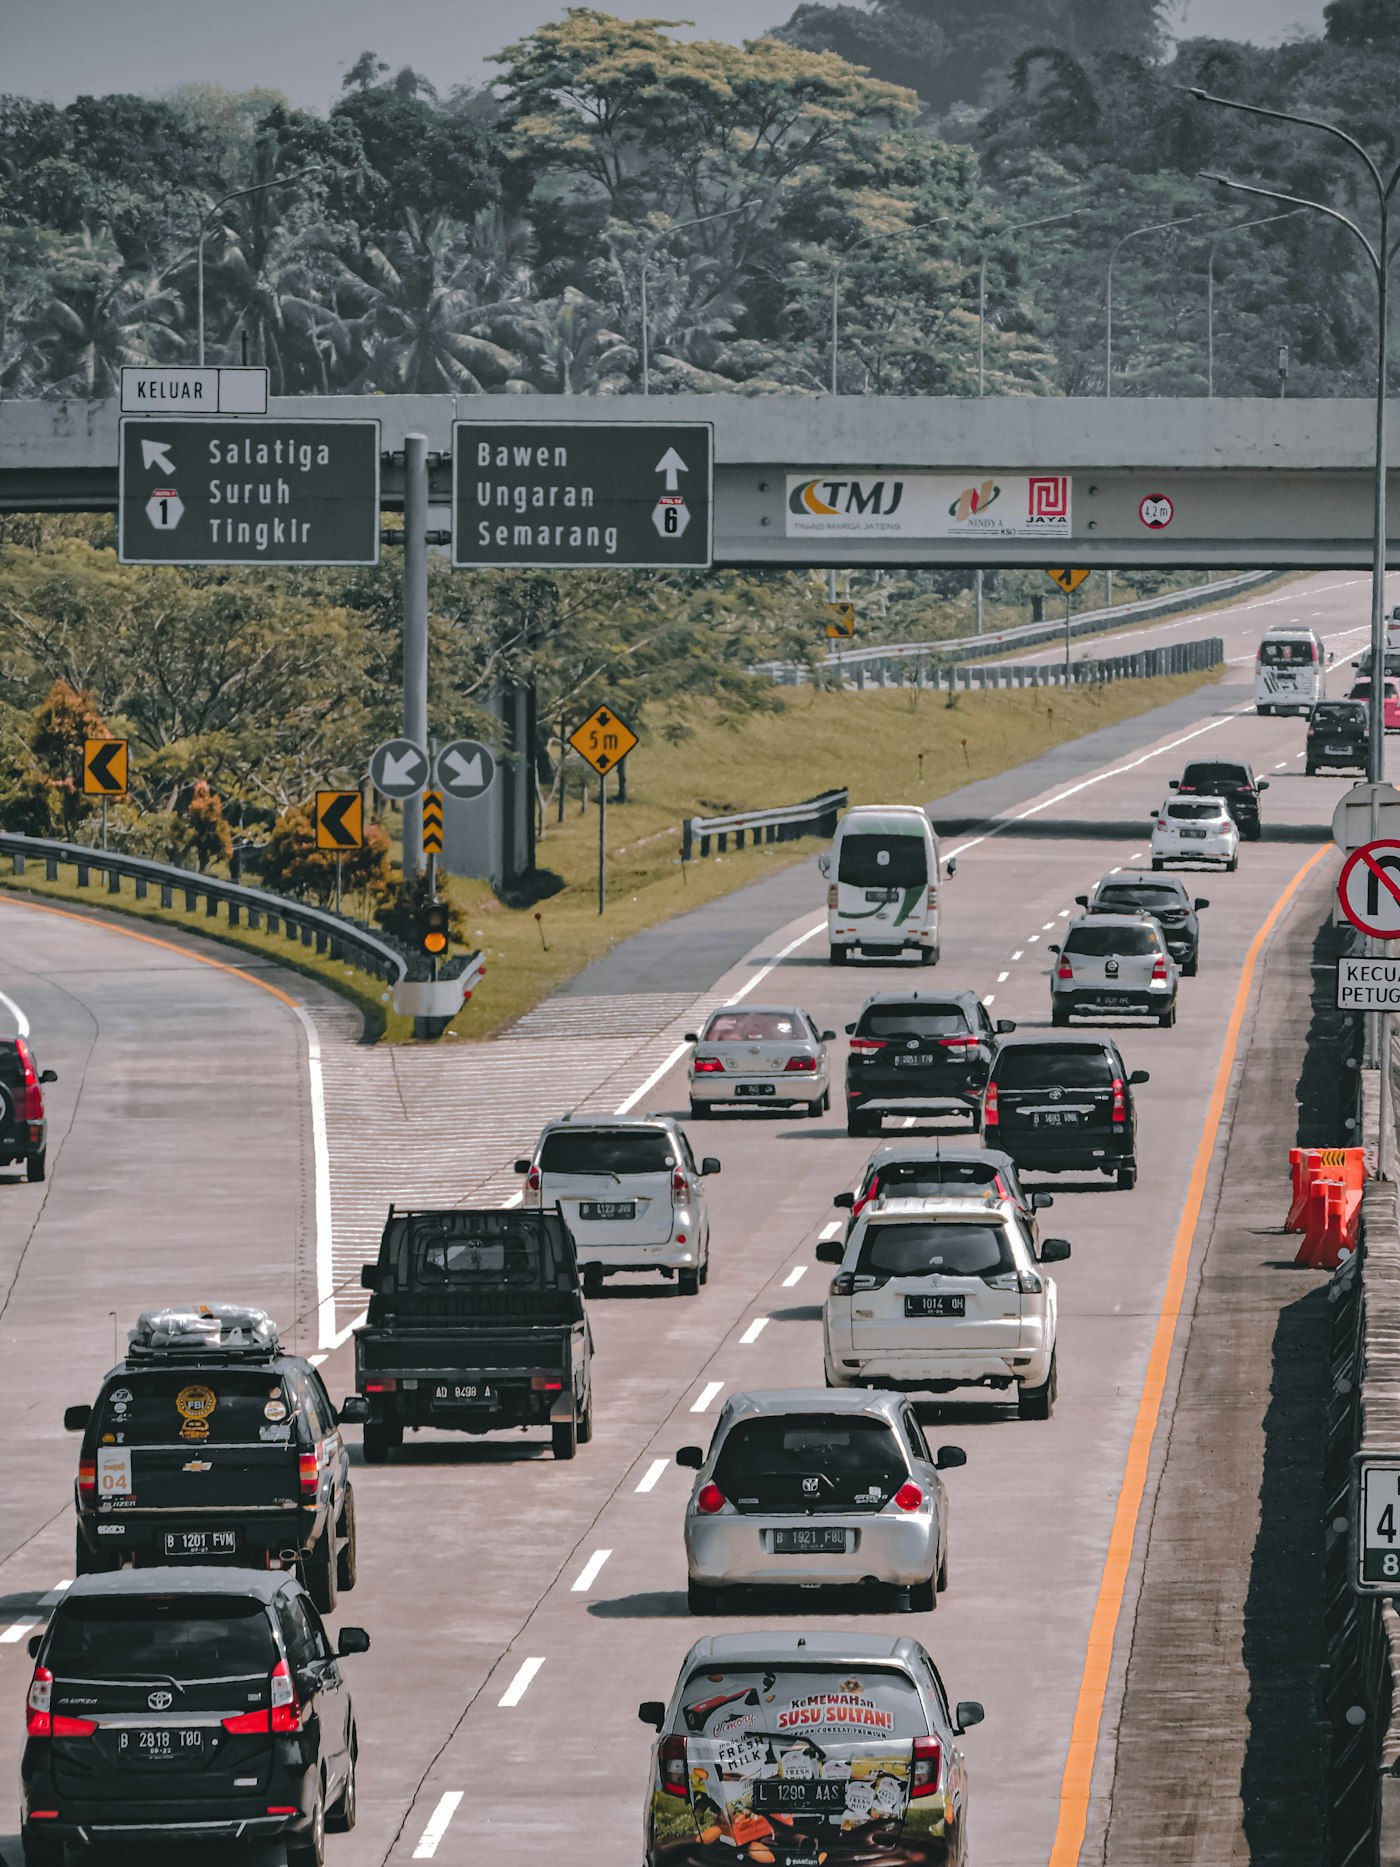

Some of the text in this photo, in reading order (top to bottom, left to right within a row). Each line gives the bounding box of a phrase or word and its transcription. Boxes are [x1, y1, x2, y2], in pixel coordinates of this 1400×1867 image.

[138, 381, 203, 398] KELUAR
[209, 439, 329, 471] Salatiga
[478, 442, 567, 466] Bawen
[209, 478, 290, 504] Suruh
[477, 482, 593, 513] Ungaran
[823, 482, 903, 515] TMJ
[159, 499, 167, 524] 1
[664, 507, 677, 533] 6
[209, 518, 310, 550] Tingkir
[478, 521, 617, 554] Semarang
[589, 731, 618, 749] 5 m
[1347, 966, 1400, 982] KECU
[908, 1298, 913, 1309] L
[923, 1298, 943, 1309] 1014
[436, 1386, 447, 1397] AD
[484, 1386, 490, 1396] A
[187, 1401, 204, 1409] FBI
[102, 1475, 127, 1490] 04
[168, 1535, 174, 1547] B
[182, 1534, 205, 1547] 1201
[777, 1532, 783, 1544] B
[793, 1531, 815, 1543] 1921
[779, 1706, 891, 1729] SUSU SULTAN!
[121, 1733, 128, 1748] B
[139, 1732, 169, 1747] 2818
[719, 1737, 763, 1760] FRESH
[728, 1750, 761, 1771] MILK
[759, 1785, 767, 1800] L
[778, 1785, 805, 1800] 1290
[816, 1785, 839, 1800] AAS
